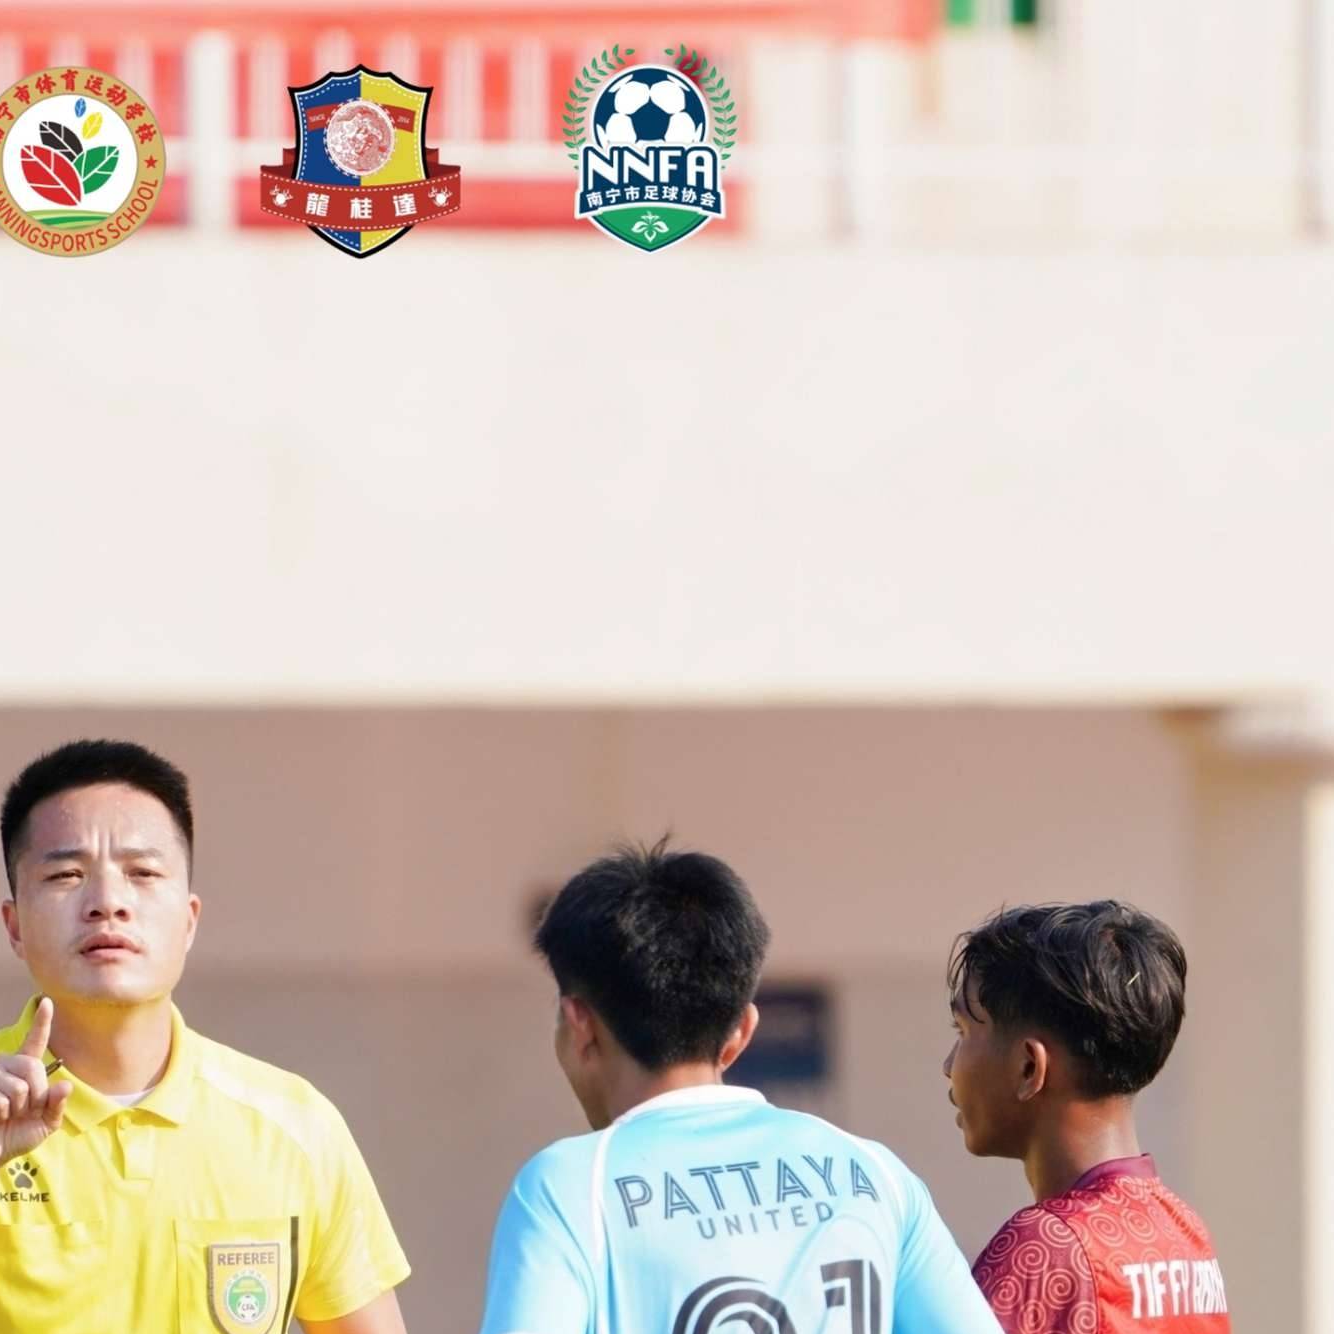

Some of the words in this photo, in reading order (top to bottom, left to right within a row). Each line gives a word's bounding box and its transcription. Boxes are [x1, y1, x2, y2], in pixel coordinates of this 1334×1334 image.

[0, 1191, 50, 1203] KELME
[614, 1154, 880, 1229] PATTAYA
[696, 1201, 835, 1240] UNITED
[217, 1252, 276, 1267] REFEREE
